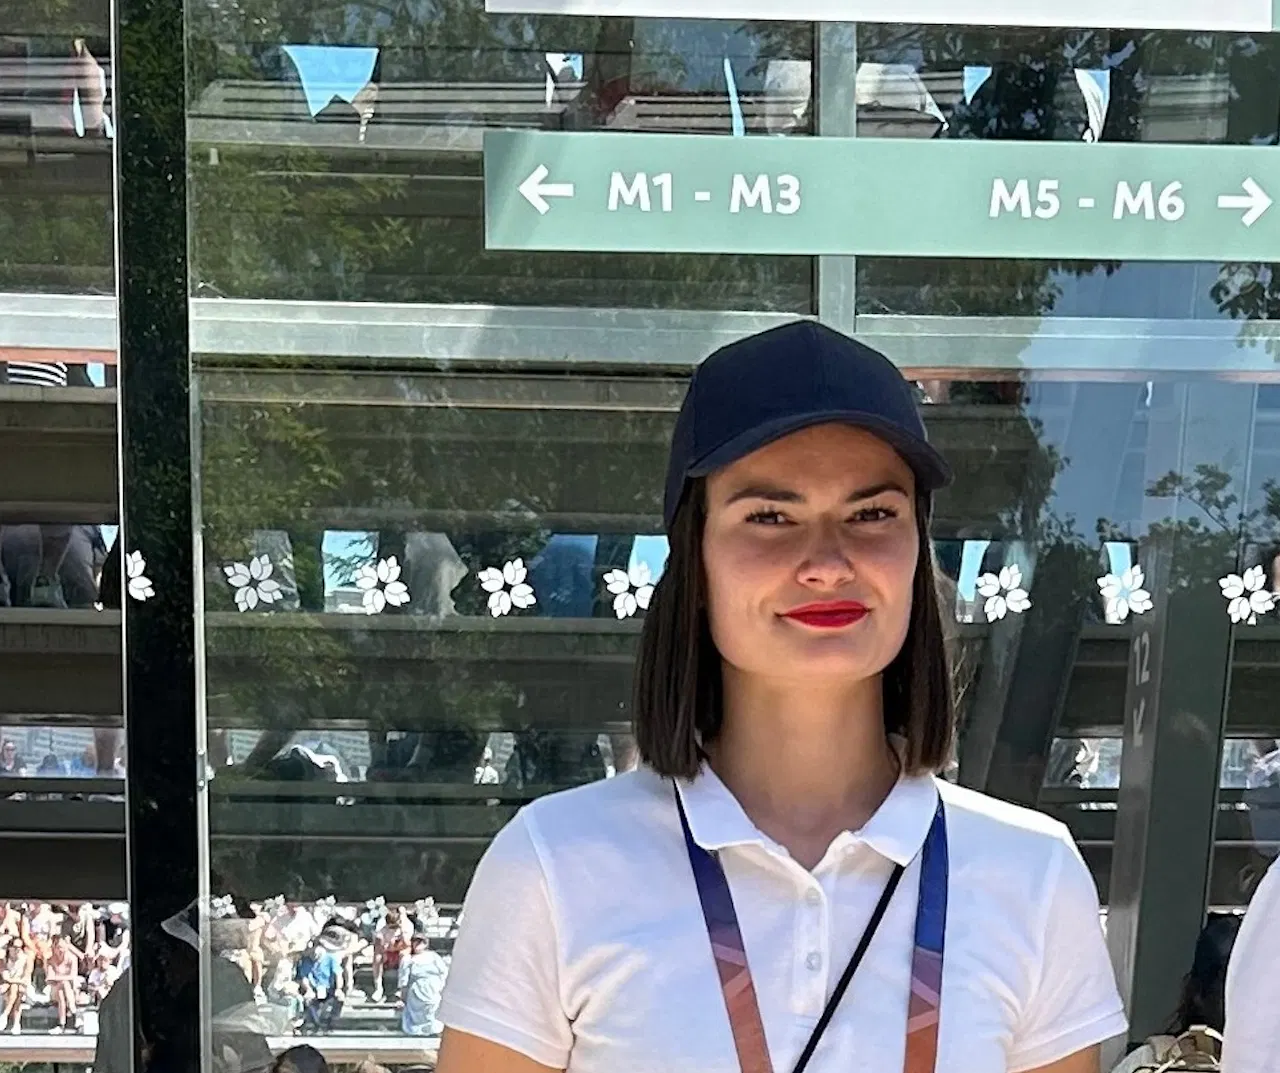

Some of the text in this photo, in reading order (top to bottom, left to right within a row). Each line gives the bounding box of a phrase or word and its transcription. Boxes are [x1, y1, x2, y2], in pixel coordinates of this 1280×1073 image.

[608, 172, 801, 214] M1 - M3
[989, 178, 1185, 221] M5 - M6
[1134, 630, 1150, 686] 12
